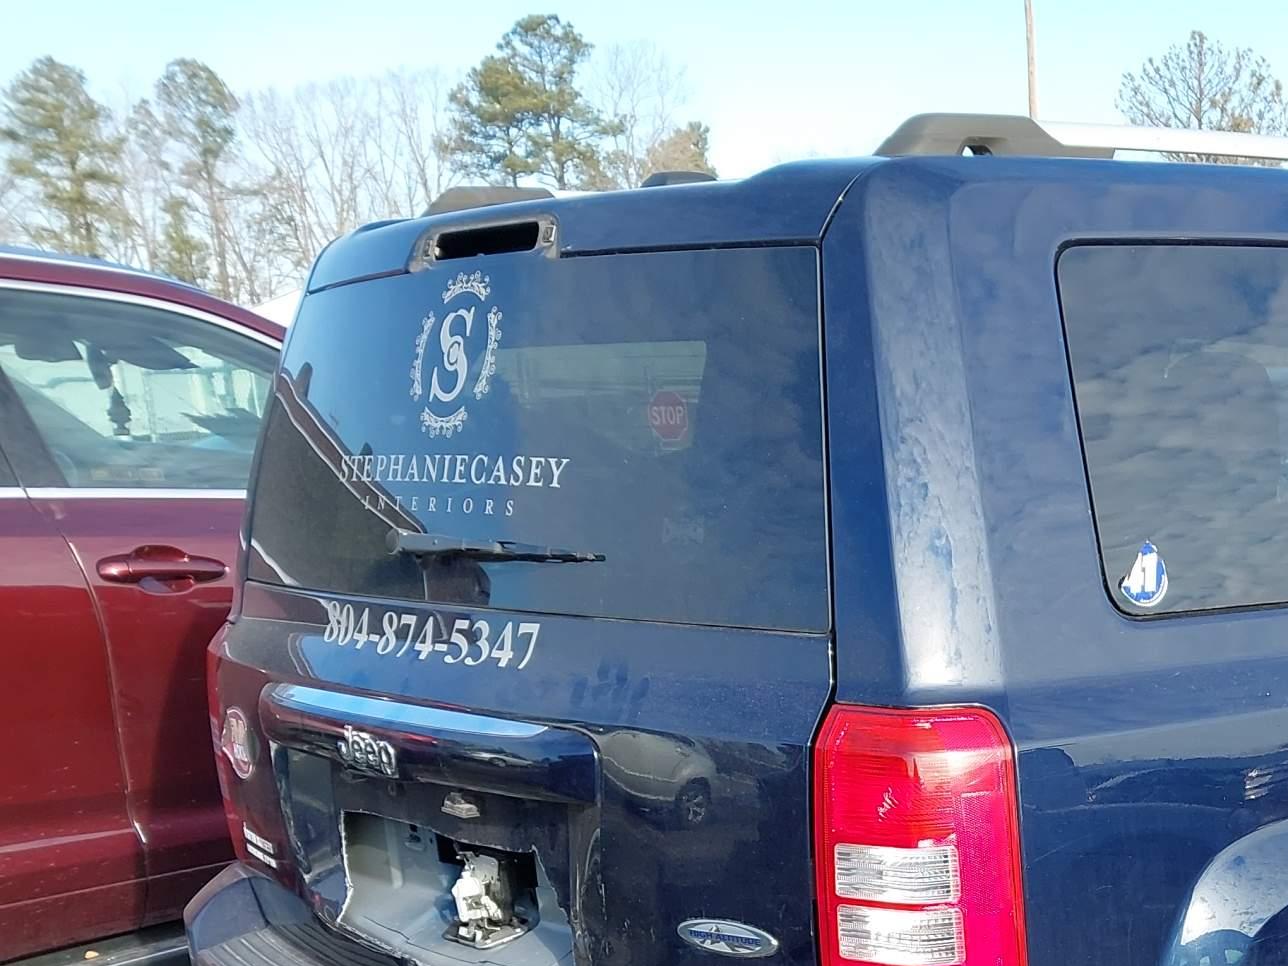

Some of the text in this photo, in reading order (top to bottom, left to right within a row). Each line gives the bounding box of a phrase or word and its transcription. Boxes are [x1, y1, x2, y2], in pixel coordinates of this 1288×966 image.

[651, 406, 684, 425] STOP
[339, 454, 570, 488] STEPHANIECASEY
[364, 495, 514, 516] INTERIORS
[323, 600, 540, 670] 804-874-5347
[337, 724, 397, 778] Jeep
